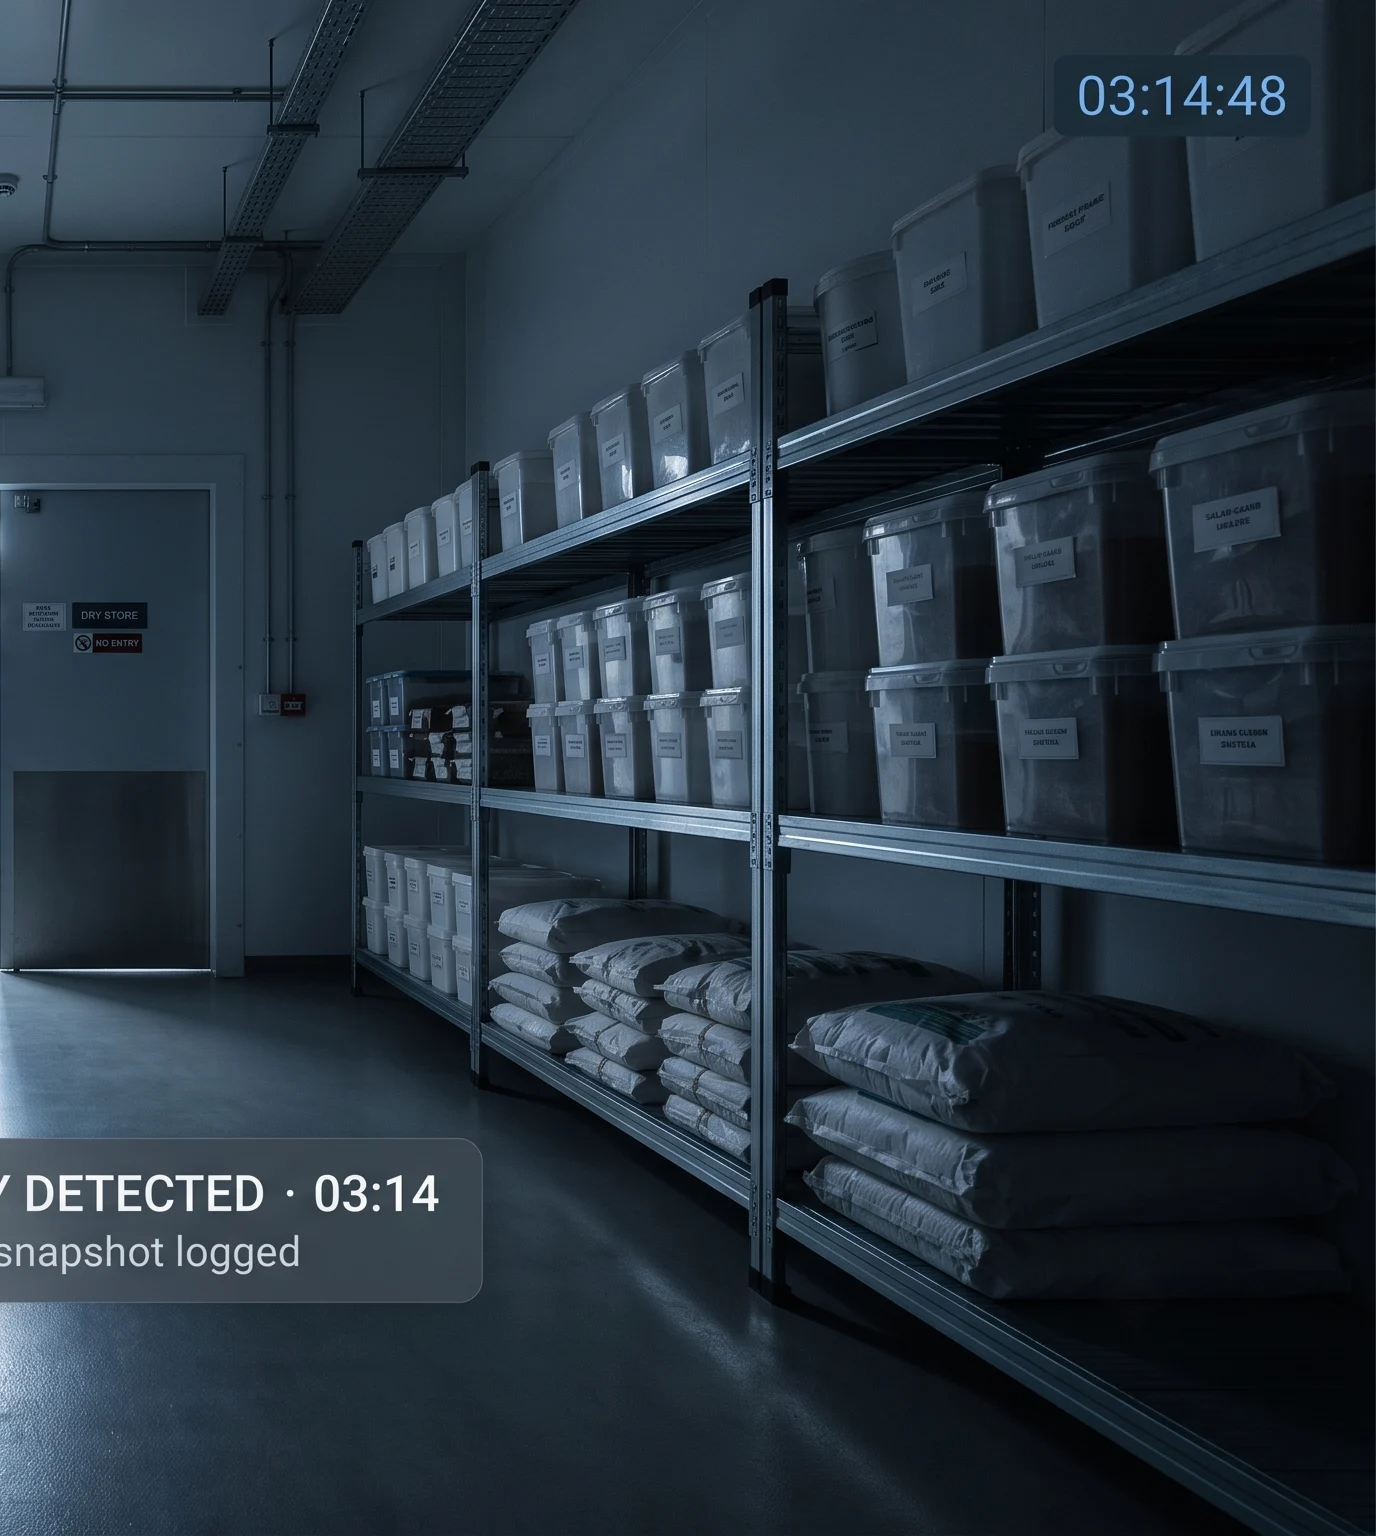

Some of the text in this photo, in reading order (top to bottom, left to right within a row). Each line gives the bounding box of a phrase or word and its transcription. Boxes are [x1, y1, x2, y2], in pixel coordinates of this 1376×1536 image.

[81, 611, 139, 620] DRY STORE
[95, 639, 139, 647] NO ENTRY
